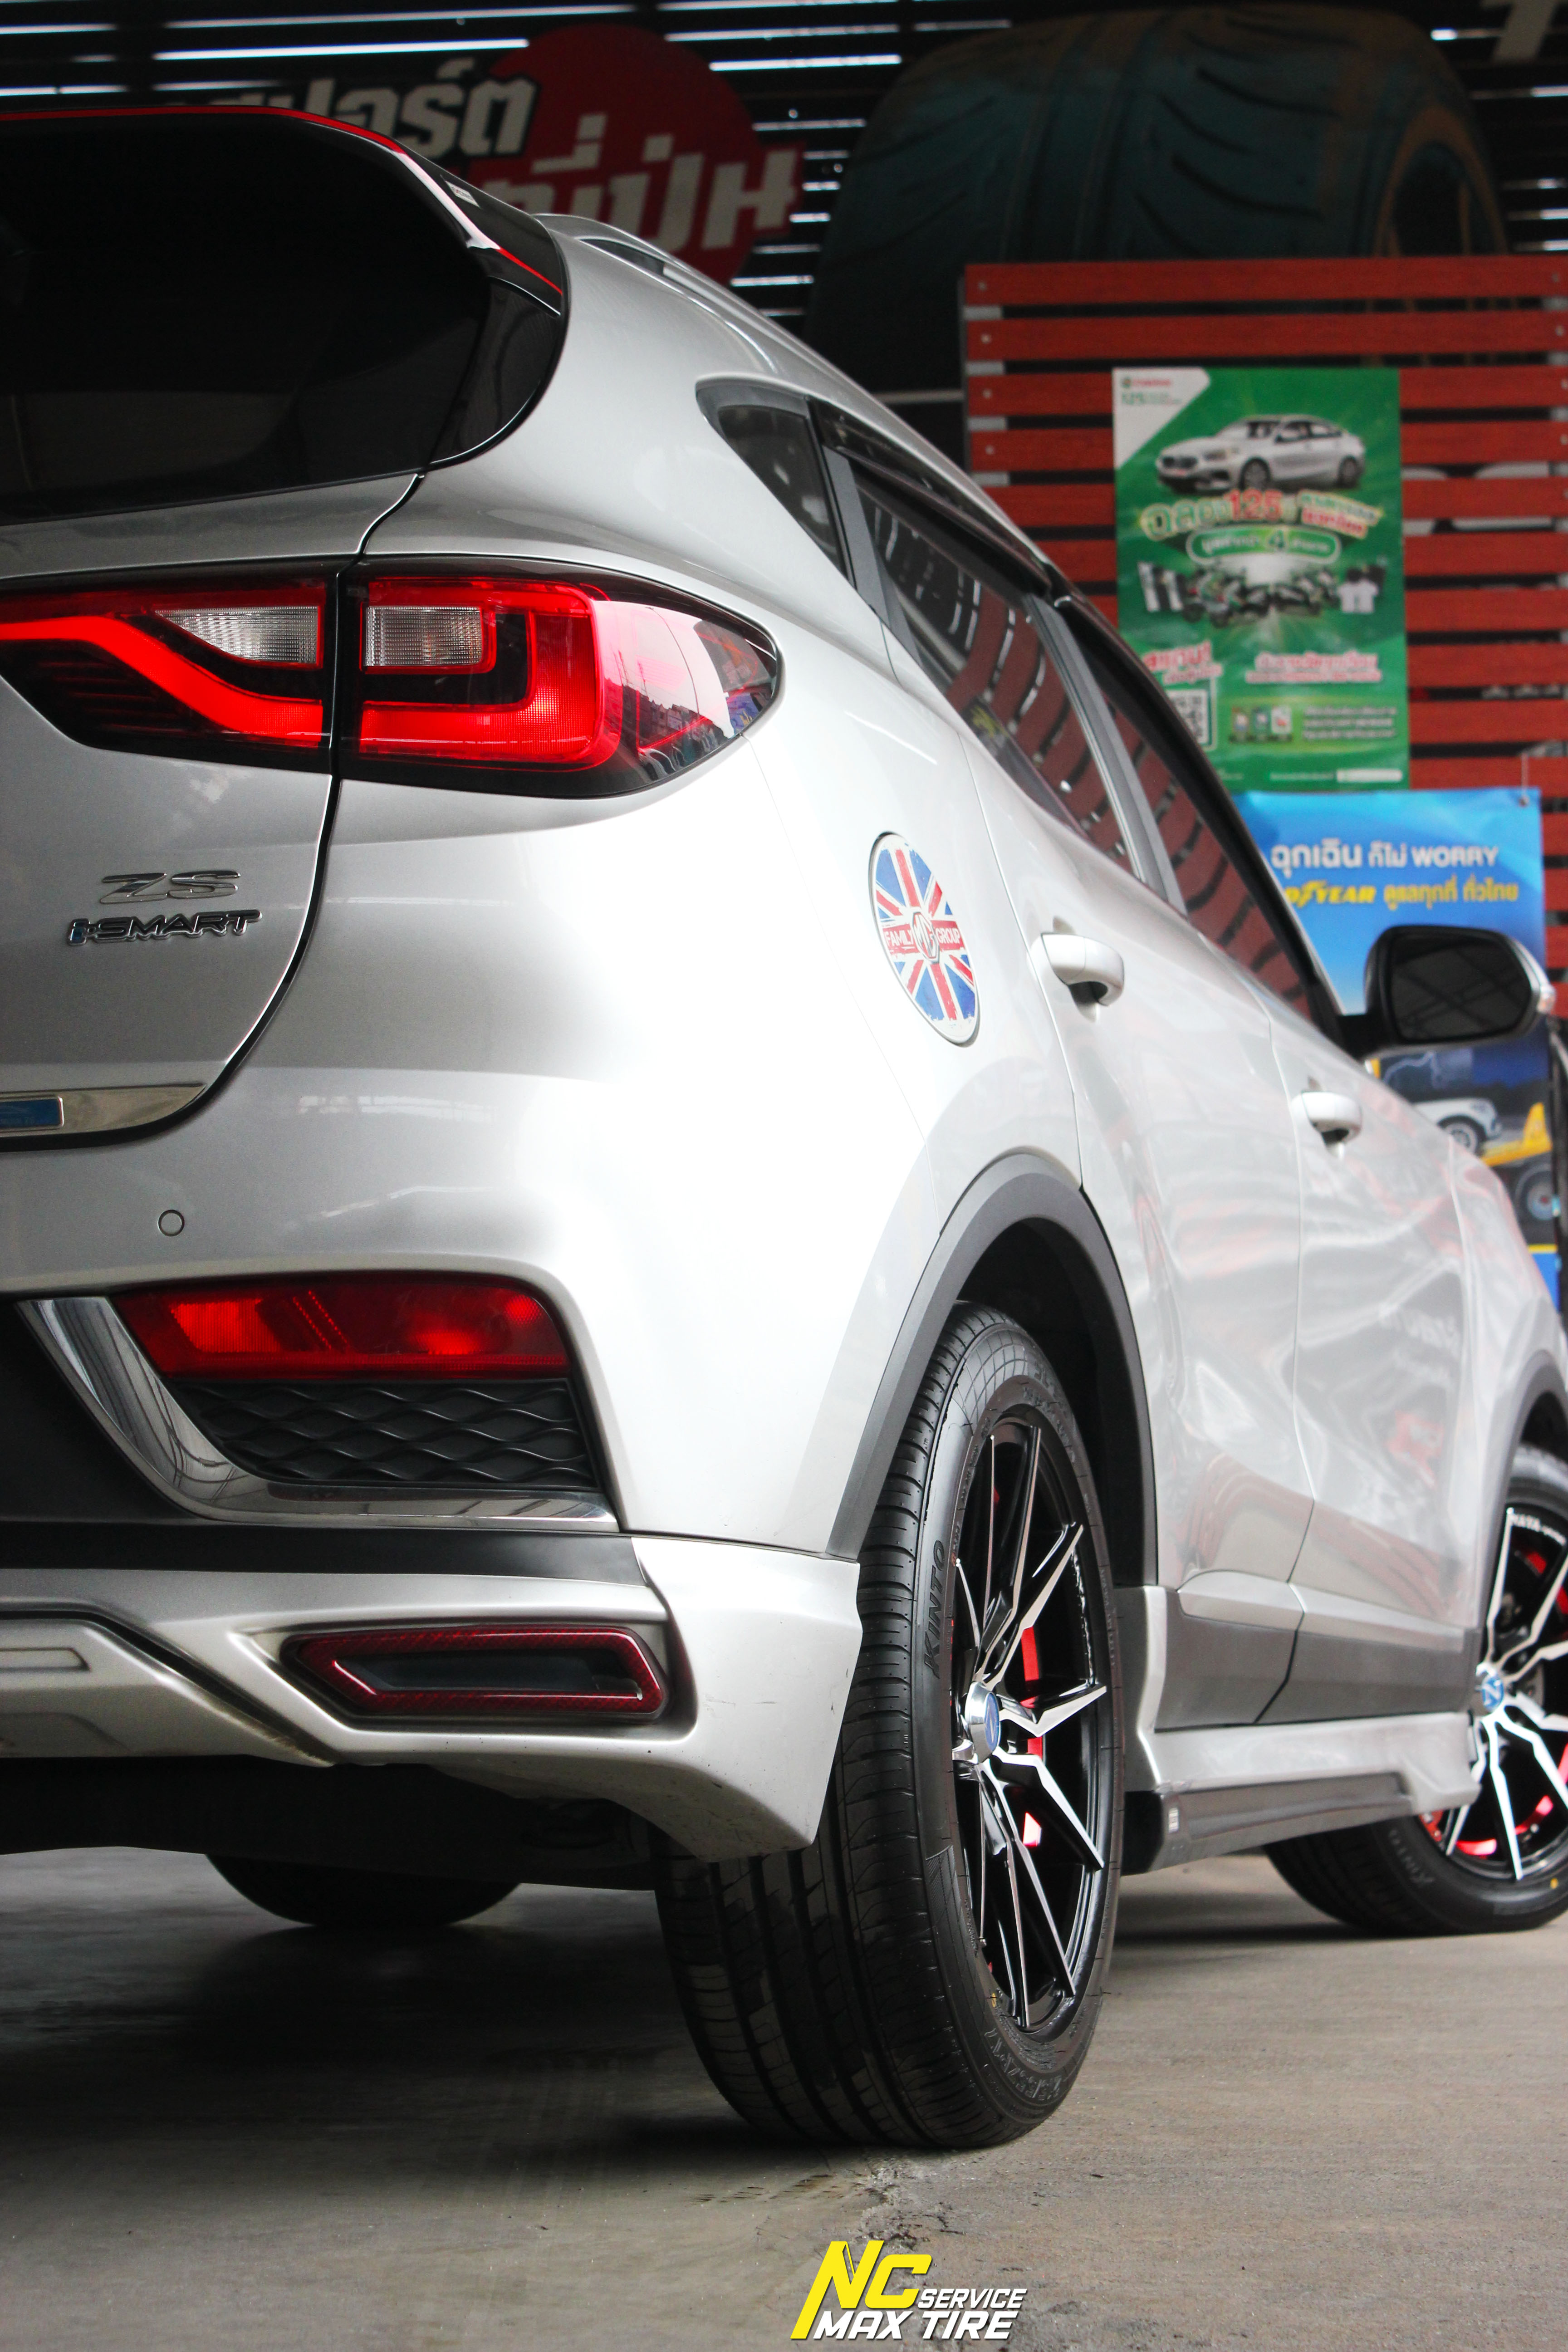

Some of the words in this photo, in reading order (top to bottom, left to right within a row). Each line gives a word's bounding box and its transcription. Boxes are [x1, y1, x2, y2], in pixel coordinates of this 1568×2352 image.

[1271, 838, 1363, 879] ฉุกเฉิน
[1411, 846, 1499, 867] WORRY
[99, 870, 241, 904] ZS
[937, 927, 961, 944] GROUP
[924, 1539, 946, 1680] KINTO
